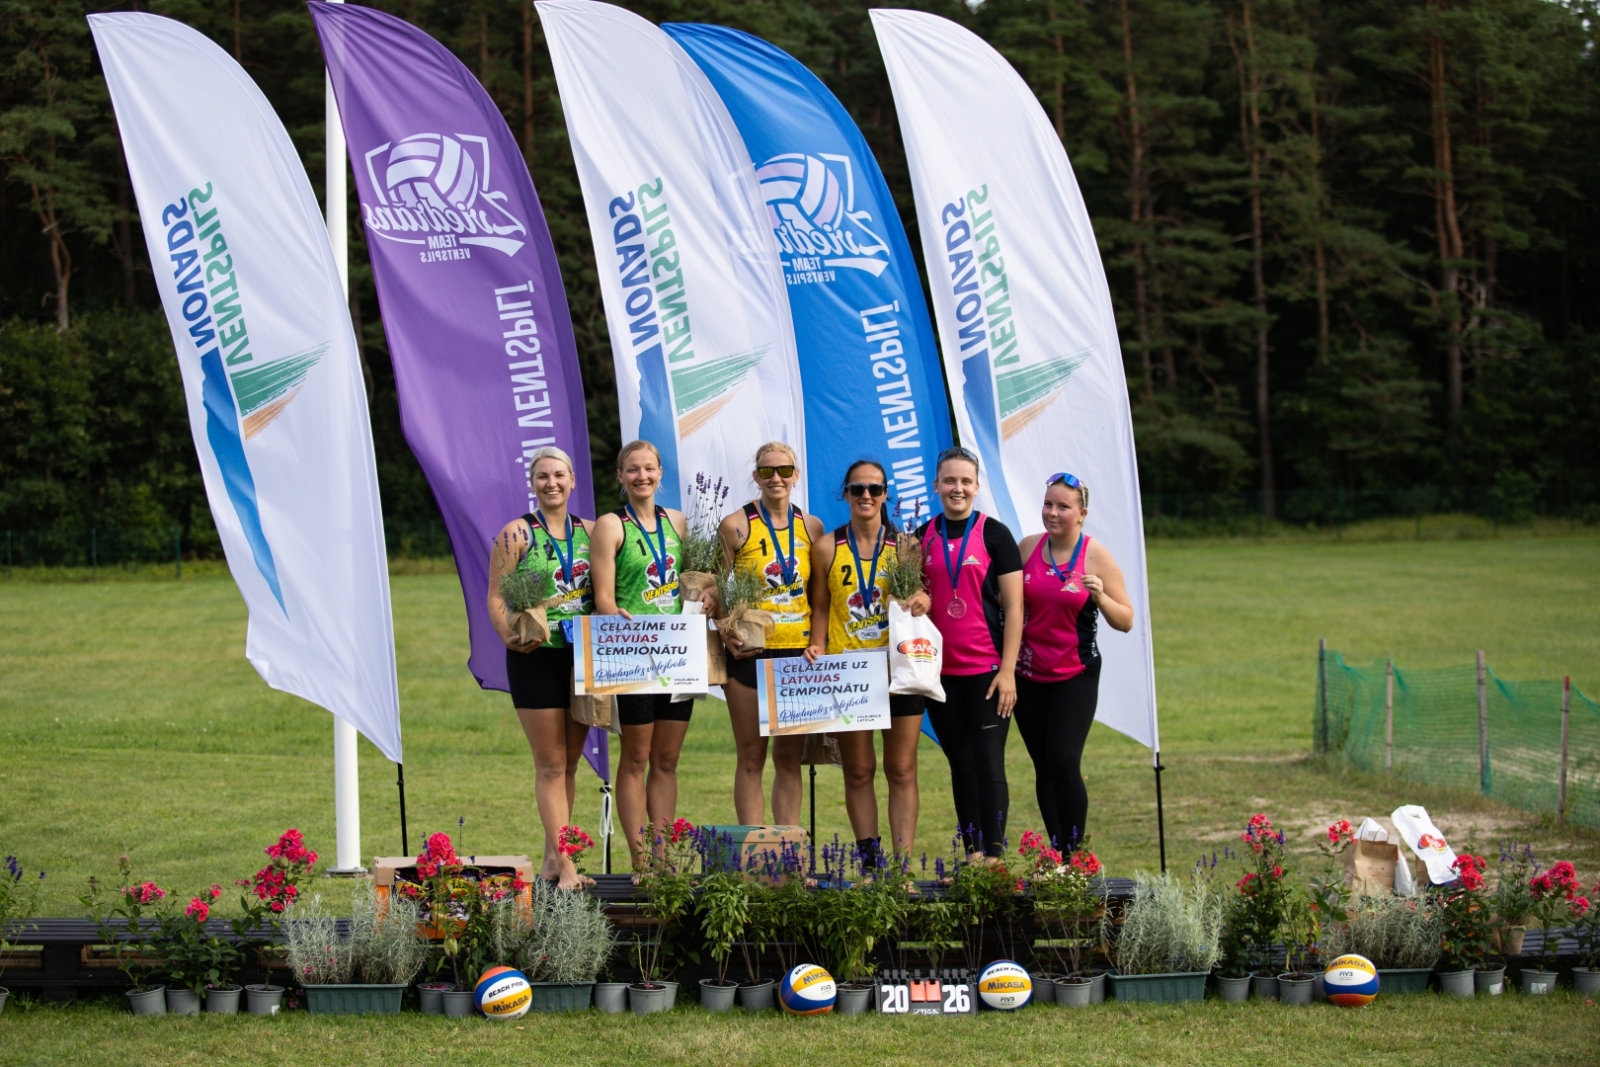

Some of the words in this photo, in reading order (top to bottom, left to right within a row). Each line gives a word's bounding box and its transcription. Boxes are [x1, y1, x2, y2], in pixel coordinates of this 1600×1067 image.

[636, 539, 647, 556] 1
[759, 538, 767, 556] 1
[841, 565, 852, 586] 2
[597, 634, 658, 643] LATVIJAS
[852, 661, 868, 669] UZ
[781, 673, 840, 685] LATVIJAS
[986, 967, 1009, 975] BEACH
[488, 984, 510, 998] BEACH
[881, 985, 909, 1012] 20
[941, 985, 970, 1012] 26
